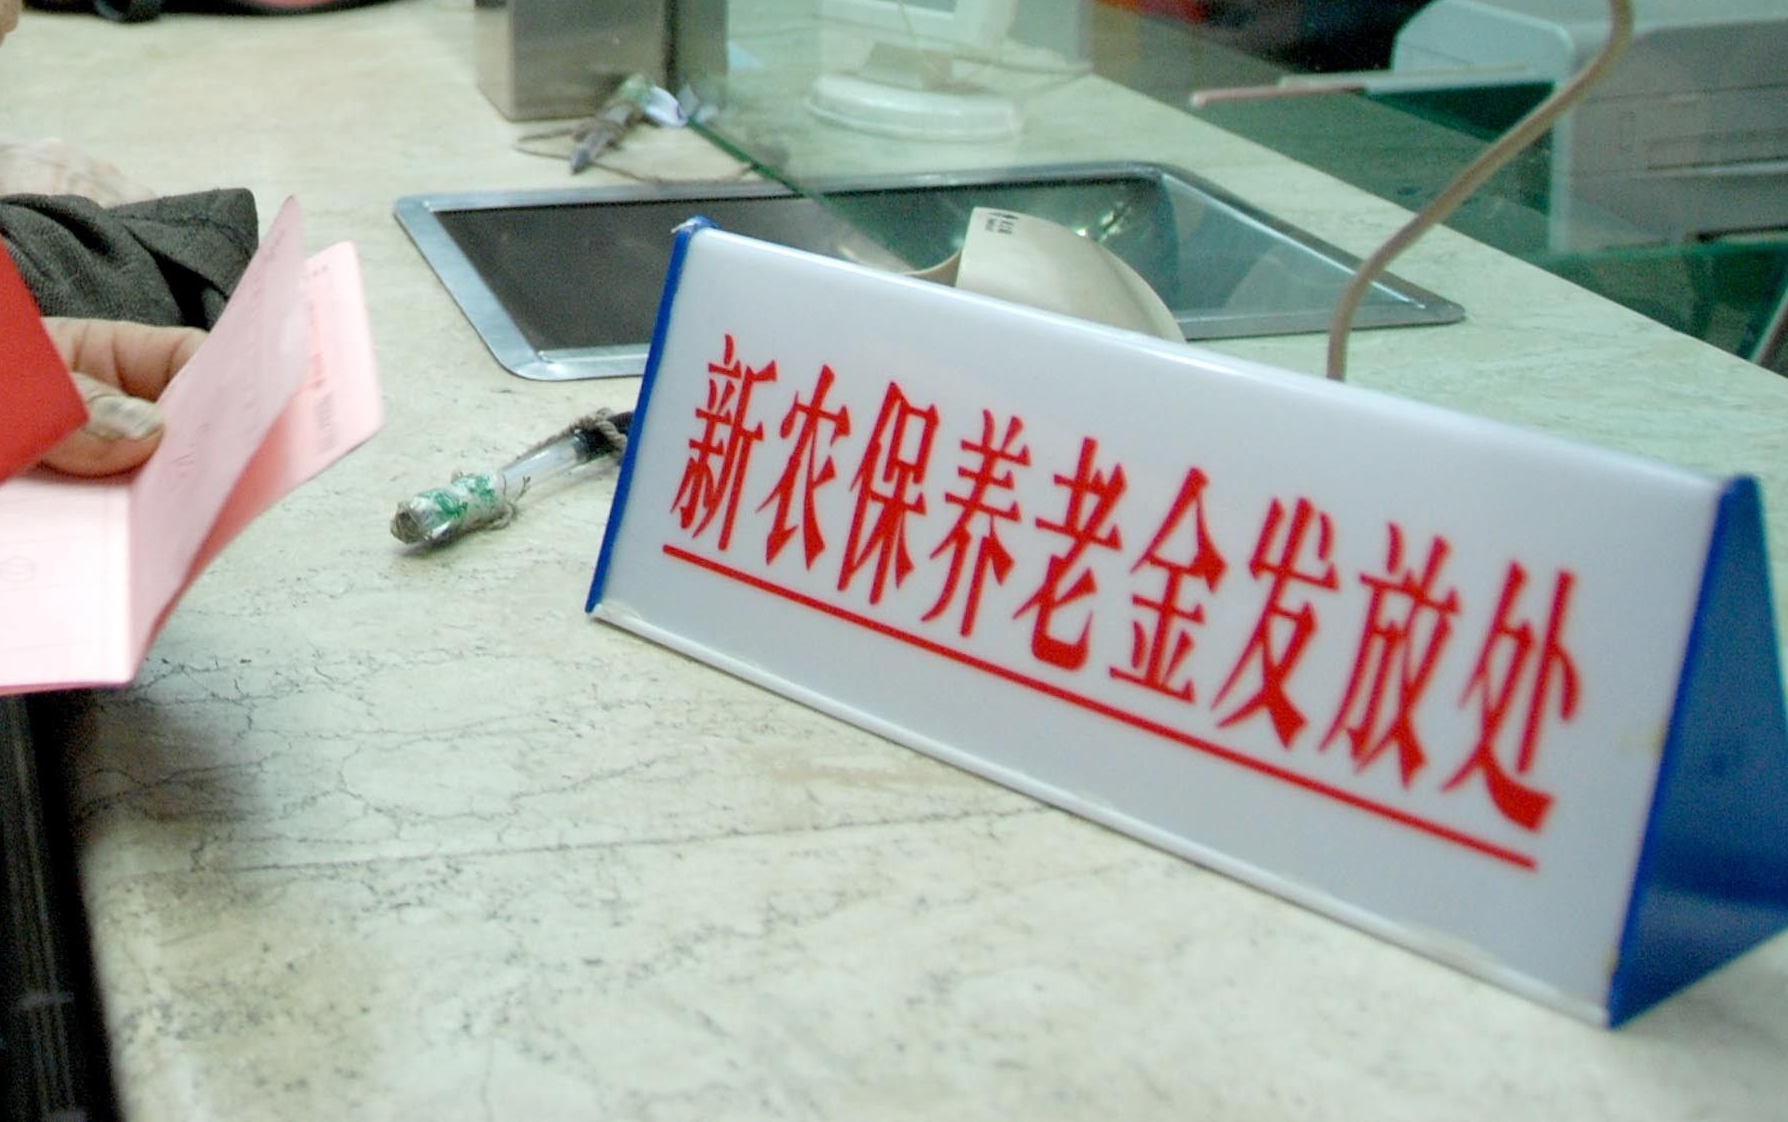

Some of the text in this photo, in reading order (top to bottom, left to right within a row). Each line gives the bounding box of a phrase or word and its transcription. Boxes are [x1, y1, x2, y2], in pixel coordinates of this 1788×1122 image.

[669, 334, 1580, 831] 新农保养老金发放处
